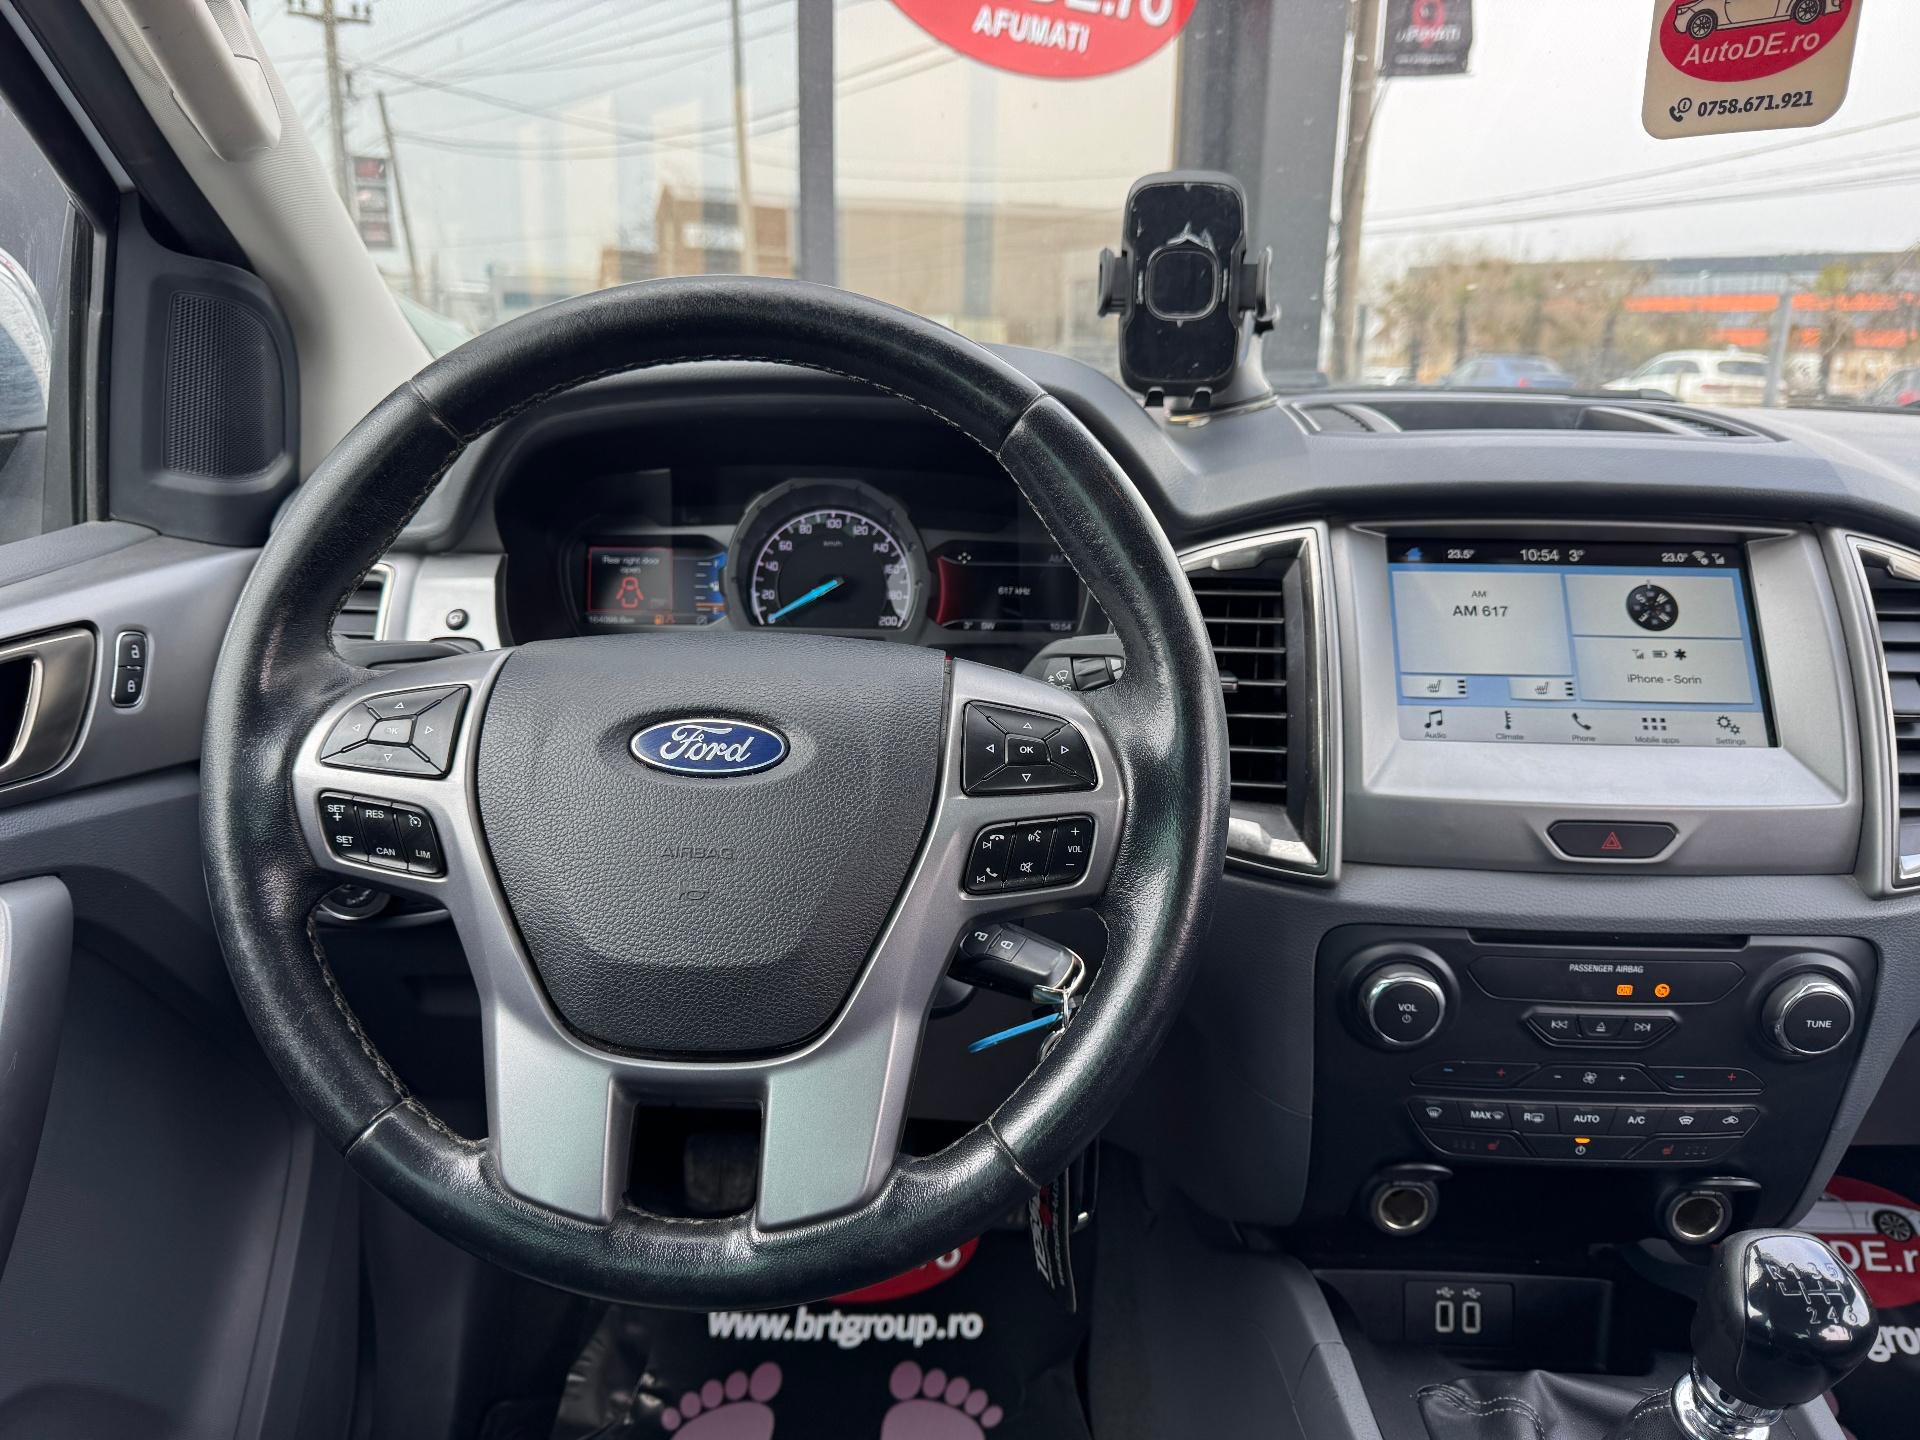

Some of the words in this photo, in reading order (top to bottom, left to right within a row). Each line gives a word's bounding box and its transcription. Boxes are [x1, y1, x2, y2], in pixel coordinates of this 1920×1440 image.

[972, 4, 1090, 53] AFUMATI
[1682, 32, 1820, 66] AutoDE.ro
[1697, 91, 1813, 117] 0758.671.921
[826, 519, 842, 529] 100
[798, 524, 812, 535] 80
[853, 525, 869, 535] 120
[778, 541, 793, 551] 60
[873, 543, 889, 553] 140
[602, 555, 620, 564] Rear
[623, 556, 640, 566] right
[642, 556, 660, 564] door
[1520, 549, 1560, 562] 10:54
[620, 567, 641, 575] open
[765, 561, 779, 571] 40
[884, 564, 900, 574] 160
[762, 590, 775, 600] 20
[998, 586, 1012, 595] 617
[1472, 590, 1488, 598] AM
[1453, 606, 1478, 617] AM
[1482, 606, 1508, 617] 617
[879, 616, 898, 627] 200
[1050, 622, 1072, 631] 10:54
[1627, 674, 1664, 684] iPhone
[1674, 674, 1702, 684] Sorin
[1424, 731, 1447, 739] Audio
[1495, 732, 1524, 741] Climate
[1572, 734, 1596, 742] Phone
[1635, 736, 1658, 744] Mobile
[660, 725, 754, 763] Ford
[1716, 737, 1747, 746] Settings
[1019, 746, 1034, 754] OK
[327, 804, 345, 813] SET
[366, 810, 385, 819] RES
[336, 835, 353, 845] SET
[376, 847, 396, 856] CAN
[415, 849, 431, 859] LIM
[660, 846, 735, 860] AIRBAG
[1067, 845, 1083, 853] VOL
[1569, 963, 1614, 973] PASSENGER
[1615, 964, 1644, 974] AIRBAG
[1397, 1003, 1417, 1012] VOL
[1806, 1019, 1832, 1029] TUNE
[1470, 1110, 1492, 1119] MAX
[1573, 1114, 1600, 1123] AUTO
[1627, 1116, 1645, 1124] A/C
[1806, 1306, 1820, 1324] 2
[1827, 1306, 1839, 1324] 4
[708, 1305, 984, 1348] www.brtgroup.ro
